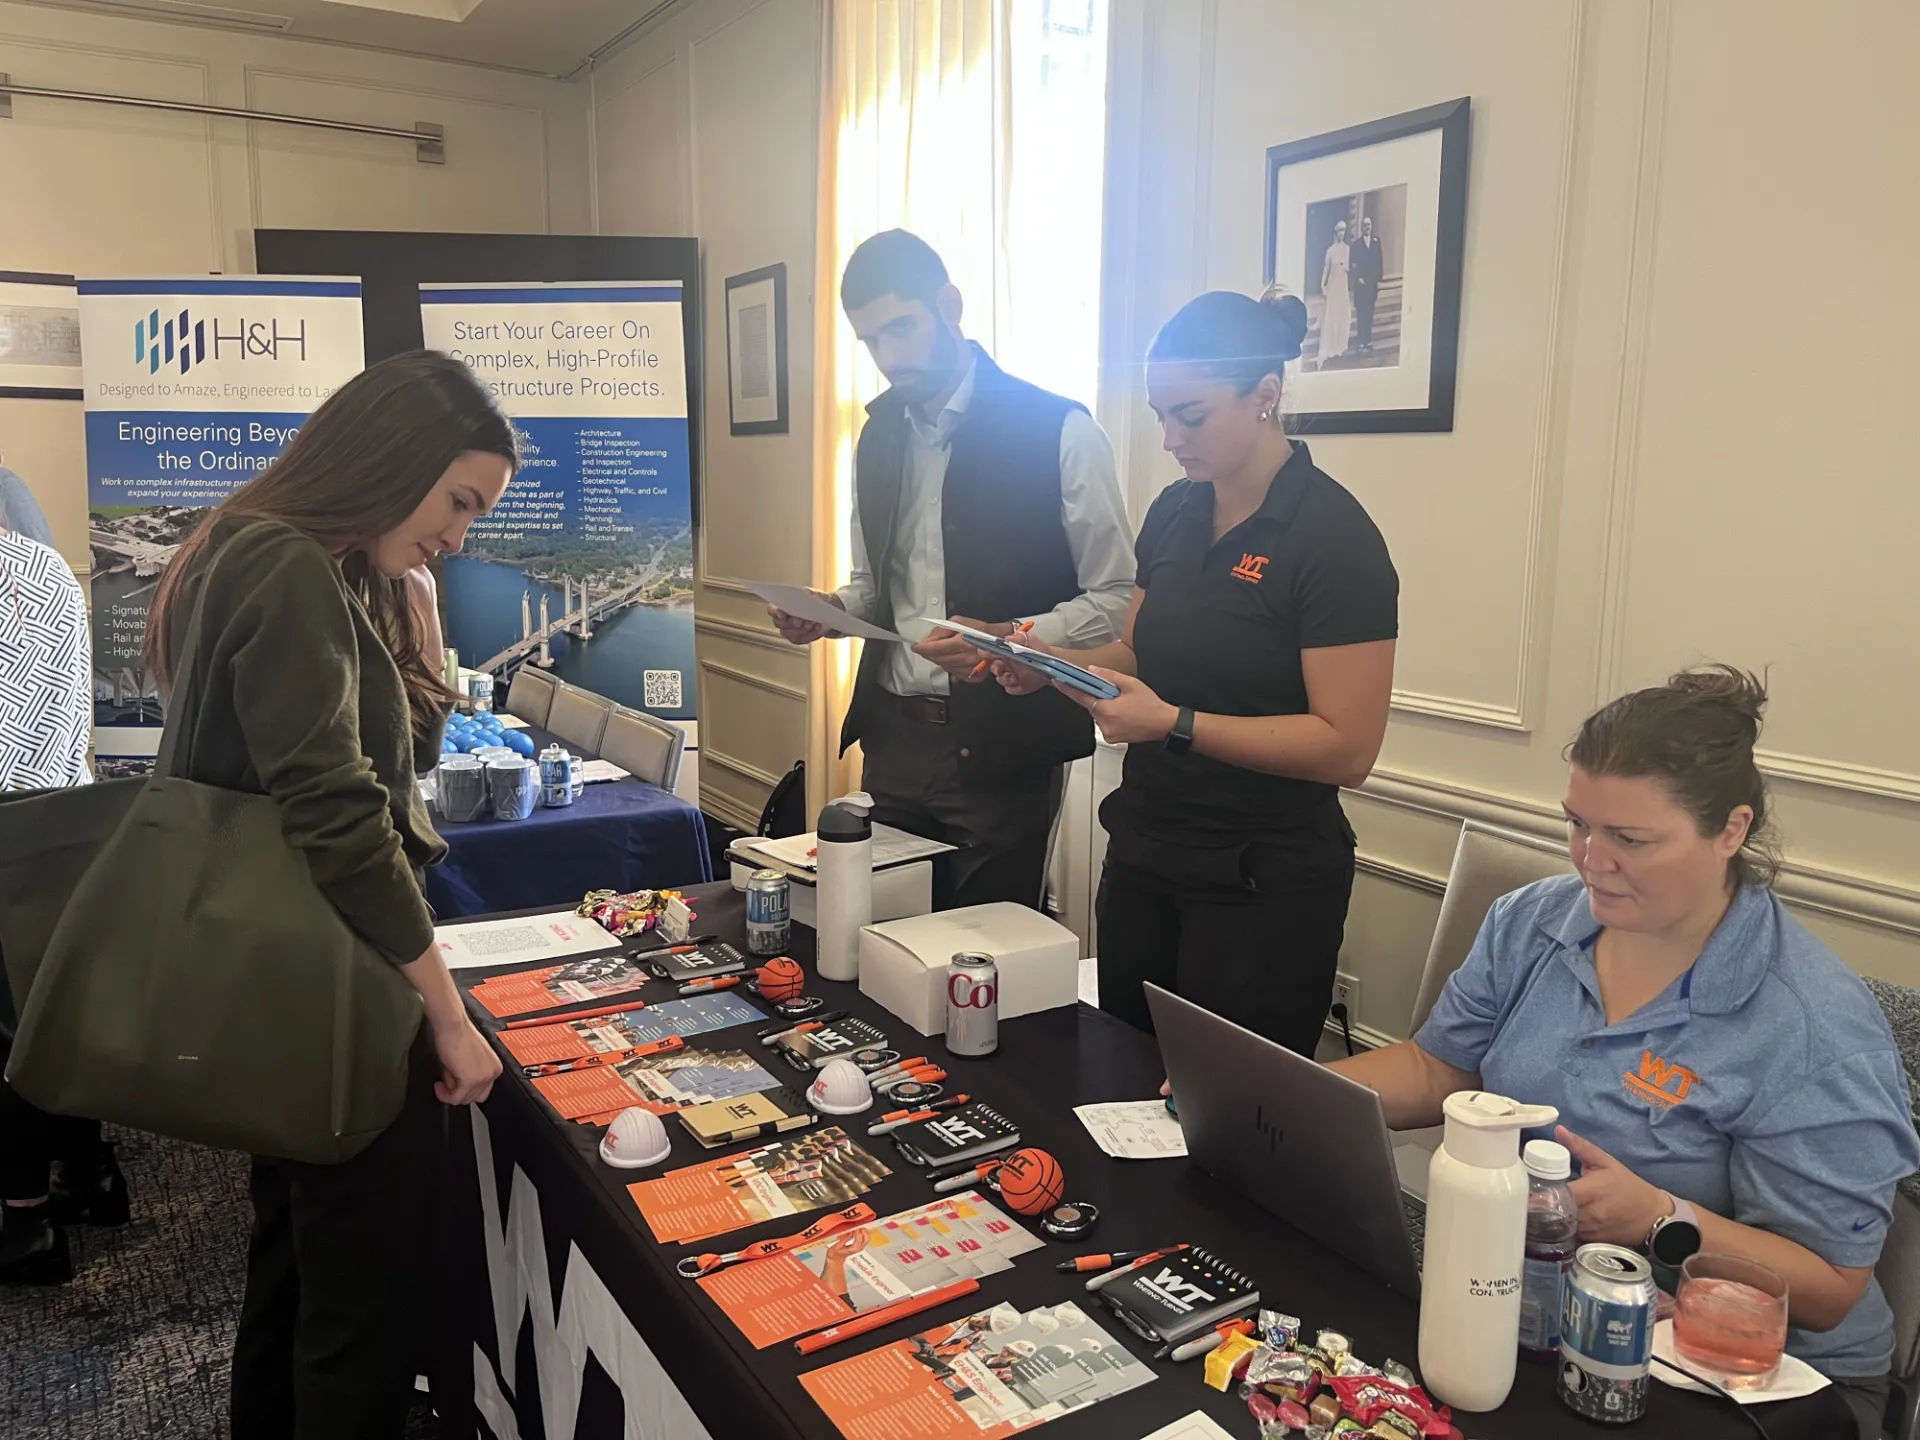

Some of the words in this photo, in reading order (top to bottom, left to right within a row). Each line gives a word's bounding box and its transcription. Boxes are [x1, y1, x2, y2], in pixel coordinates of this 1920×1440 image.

[454, 321, 499, 340] Start
[503, 321, 544, 340] Your
[551, 320, 615, 340] Career
[622, 320, 650, 339] On
[213, 318, 306, 360] H&H
[547, 349, 659, 371] High-Profile
[100, 383, 154, 398] Designed
[158, 385, 170, 396] to
[174, 384, 220, 398] Amaze,
[224, 384, 295, 399] Engineered
[299, 385, 311, 397] to
[488, 378, 573, 396] structure
[581, 377, 665, 400] Projects.
[119, 421, 241, 445] Engineering
[580, 429, 621, 437] Architecture
[581, 439, 602, 447] Bridge
[626, 449, 667, 458] Engineering
[157, 451, 191, 470] the
[200, 451, 279, 471] Ordinar
[596, 459, 631, 467] Inspection
[101, 478, 121, 486] Work
[136, 478, 172, 488] complex
[175, 479, 231, 487] infrastructure
[128, 490, 158, 498] expand
[183, 490, 229, 498] experience
[539, 491, 554, 499] part
[583, 487, 613, 495] Highway,
[584, 496, 618, 504] Hydraulics
[526, 502, 566, 510] beginning,
[506, 522, 541, 530] expertise
[503, 532, 524, 540] apart.
[112, 605, 148, 616] Signatu
[113, 619, 146, 629] Movab
[113, 633, 131, 643] Rail
[684, 950, 715, 966] WT
[815, 1028, 854, 1047] WT
[1640, 1049, 1701, 1099] WT
[734, 1103, 757, 1118] WT
[942, 1115, 987, 1140] WT
[1009, 1154, 1035, 1170] WT
[760, 1241, 782, 1253] WT
[1153, 1266, 1216, 1303] WT
